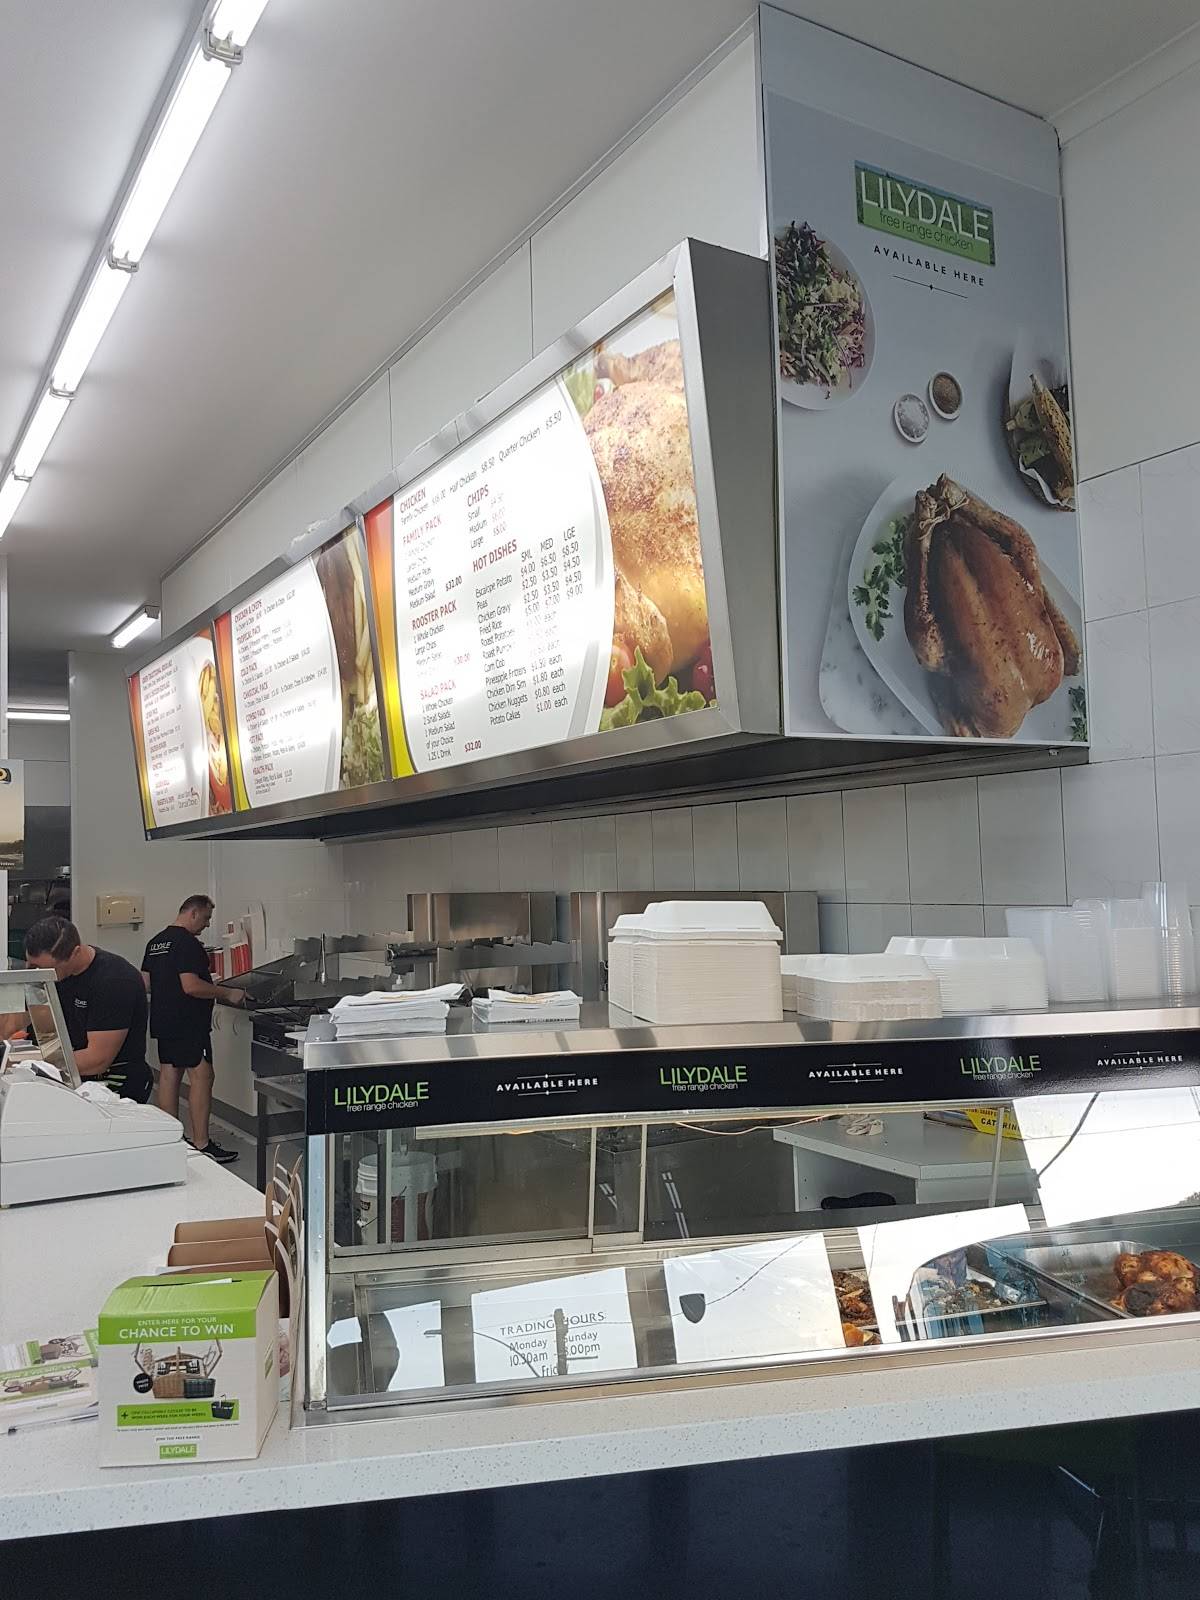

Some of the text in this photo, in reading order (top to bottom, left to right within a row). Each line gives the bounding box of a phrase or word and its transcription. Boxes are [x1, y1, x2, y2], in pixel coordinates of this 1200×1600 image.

[861, 172, 990, 243] LILYDALE
[880, 210, 973, 251] free range chicken
[874, 245, 984, 287] AVAILABLE HERE
[499, 442, 519, 463] Quarter
[520, 428, 540, 448] Chicken
[400, 488, 426, 514] CHICKEN
[467, 485, 489, 507] CHIPS
[468, 507, 480, 522] Small
[426, 516, 441, 532] PACK
[470, 518, 488, 535] Medium
[471, 536, 484, 550] Large
[521, 527, 578, 563] SML MED LGE
[473, 540, 518, 572] HOT DISHES
[497, 574, 513, 588] Potato
[521, 562, 536, 577] $4.00
[540, 552, 557, 568] $6.50
[562, 541, 580, 558] $8.50
[477, 556, 581, 610] Peas $2.50 $3.50 $4.50
[478, 610, 496, 624] Chicken
[497, 604, 511, 618] Gravy
[565, 571, 583, 586] $4.50
[412, 602, 457, 630] ROOSTER PACK
[480, 625, 491, 636] Fried
[492, 620, 502, 631] Rice
[481, 636, 494, 648] Roast
[486, 672, 508, 688] Pineapple
[549, 655, 563, 665] each
[487, 686, 505, 699] Chicken
[551, 668, 564, 679] each
[488, 700, 507, 712] Chicken
[508, 694, 529, 709] Nuggets
[552, 683, 566, 694] each
[490, 697, 568, 726] Potato Cakes $1.00 each
[464, 741, 482, 752] $32.00
[960, 1055, 1041, 1075] LILYDALE
[1097, 1055, 1183, 1066] AVAILABLE HERE
[660, 1066, 747, 1085] LILYDALE
[809, 1068, 903, 1078] AVAILABLE HERE
[973, 1073, 986, 1081] free
[987, 1073, 1006, 1081] range
[497, 1077, 598, 1092] AVAILABLE HERE
[672, 1081, 738, 1092] free range chicken
[334, 1082, 429, 1106] LILYDALE
[347, 1100, 418, 1113] free range chicken
[981, 1117, 1020, 1131] CATRIN
[198, 1316, 217, 1324] YOUR
[500, 1319, 555, 1336] TRADING
[119, 1323, 234, 1339] CHANCE TO WIN
[509, 1338, 547, 1352] Monday
[510, 1352, 548, 1367] 10.30am
